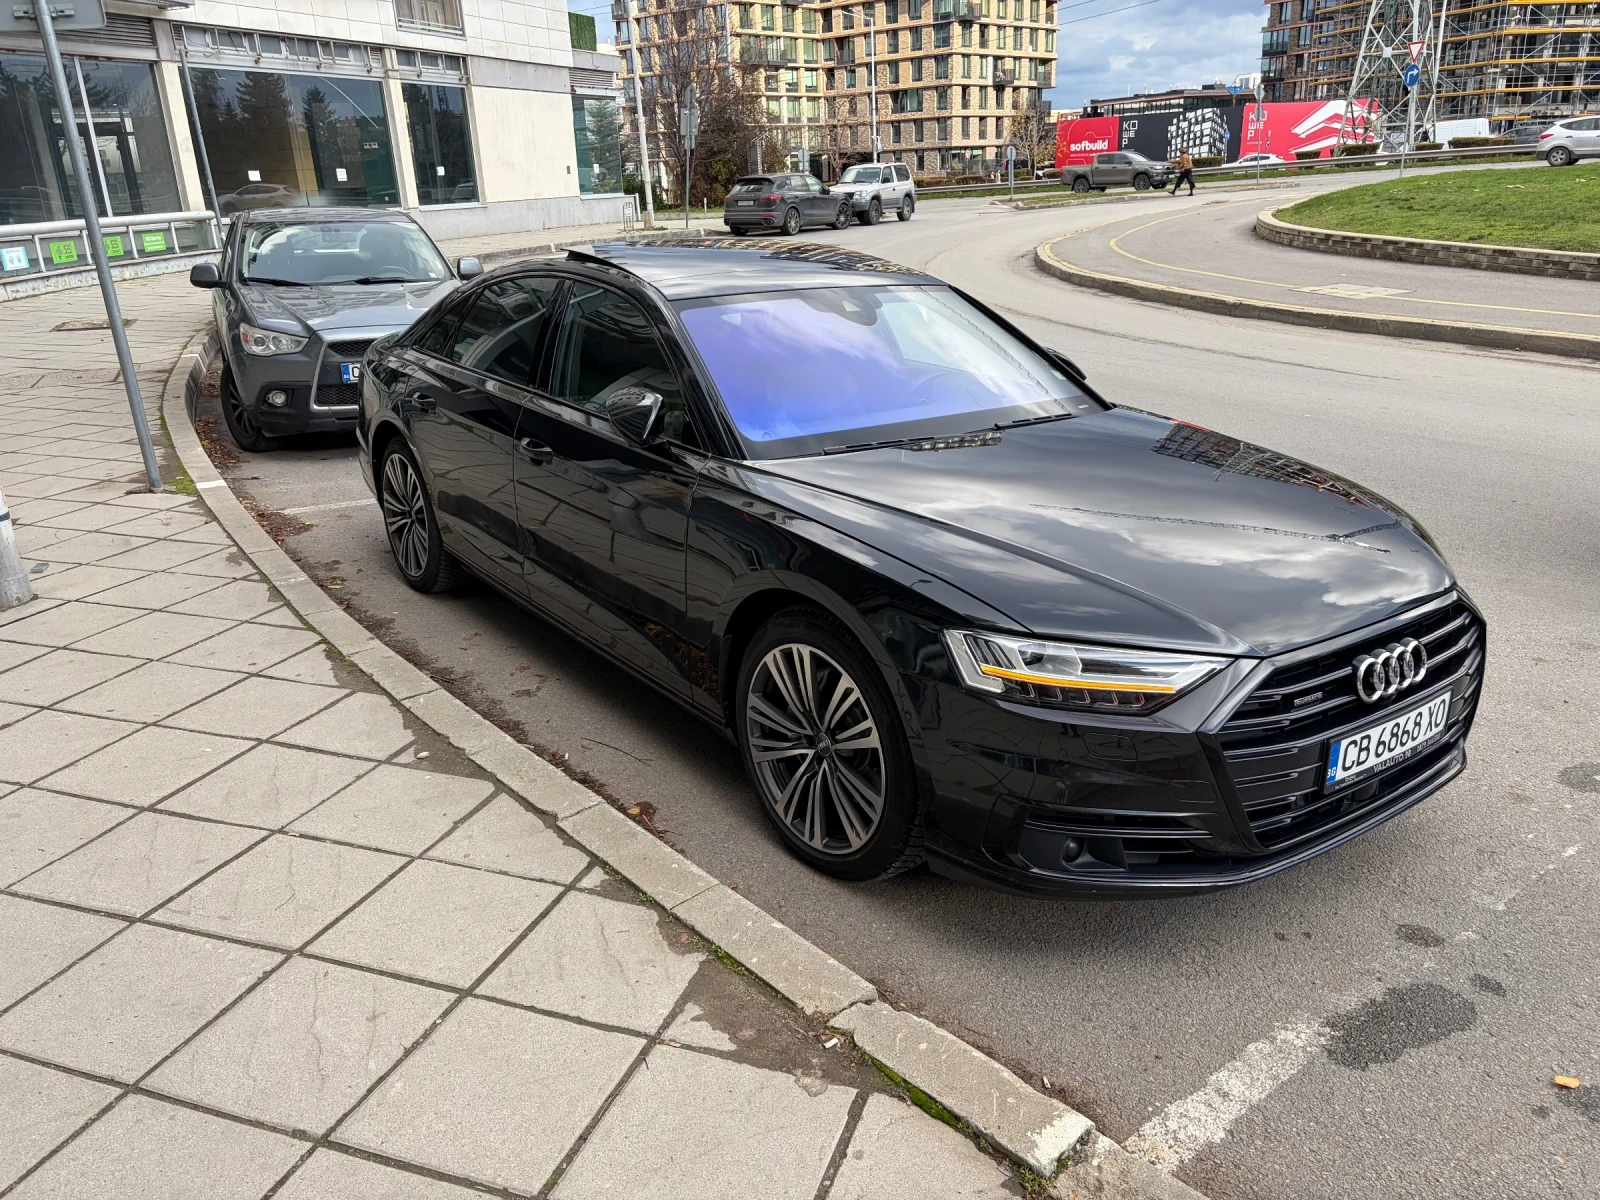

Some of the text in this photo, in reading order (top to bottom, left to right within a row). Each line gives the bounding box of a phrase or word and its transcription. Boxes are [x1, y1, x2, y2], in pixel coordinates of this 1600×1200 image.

[1070, 139, 1108, 152] sofbuild
[1341, 698, 1446, 772] CB 6868 XO
[1373, 754, 1403, 773] VALAUTO
